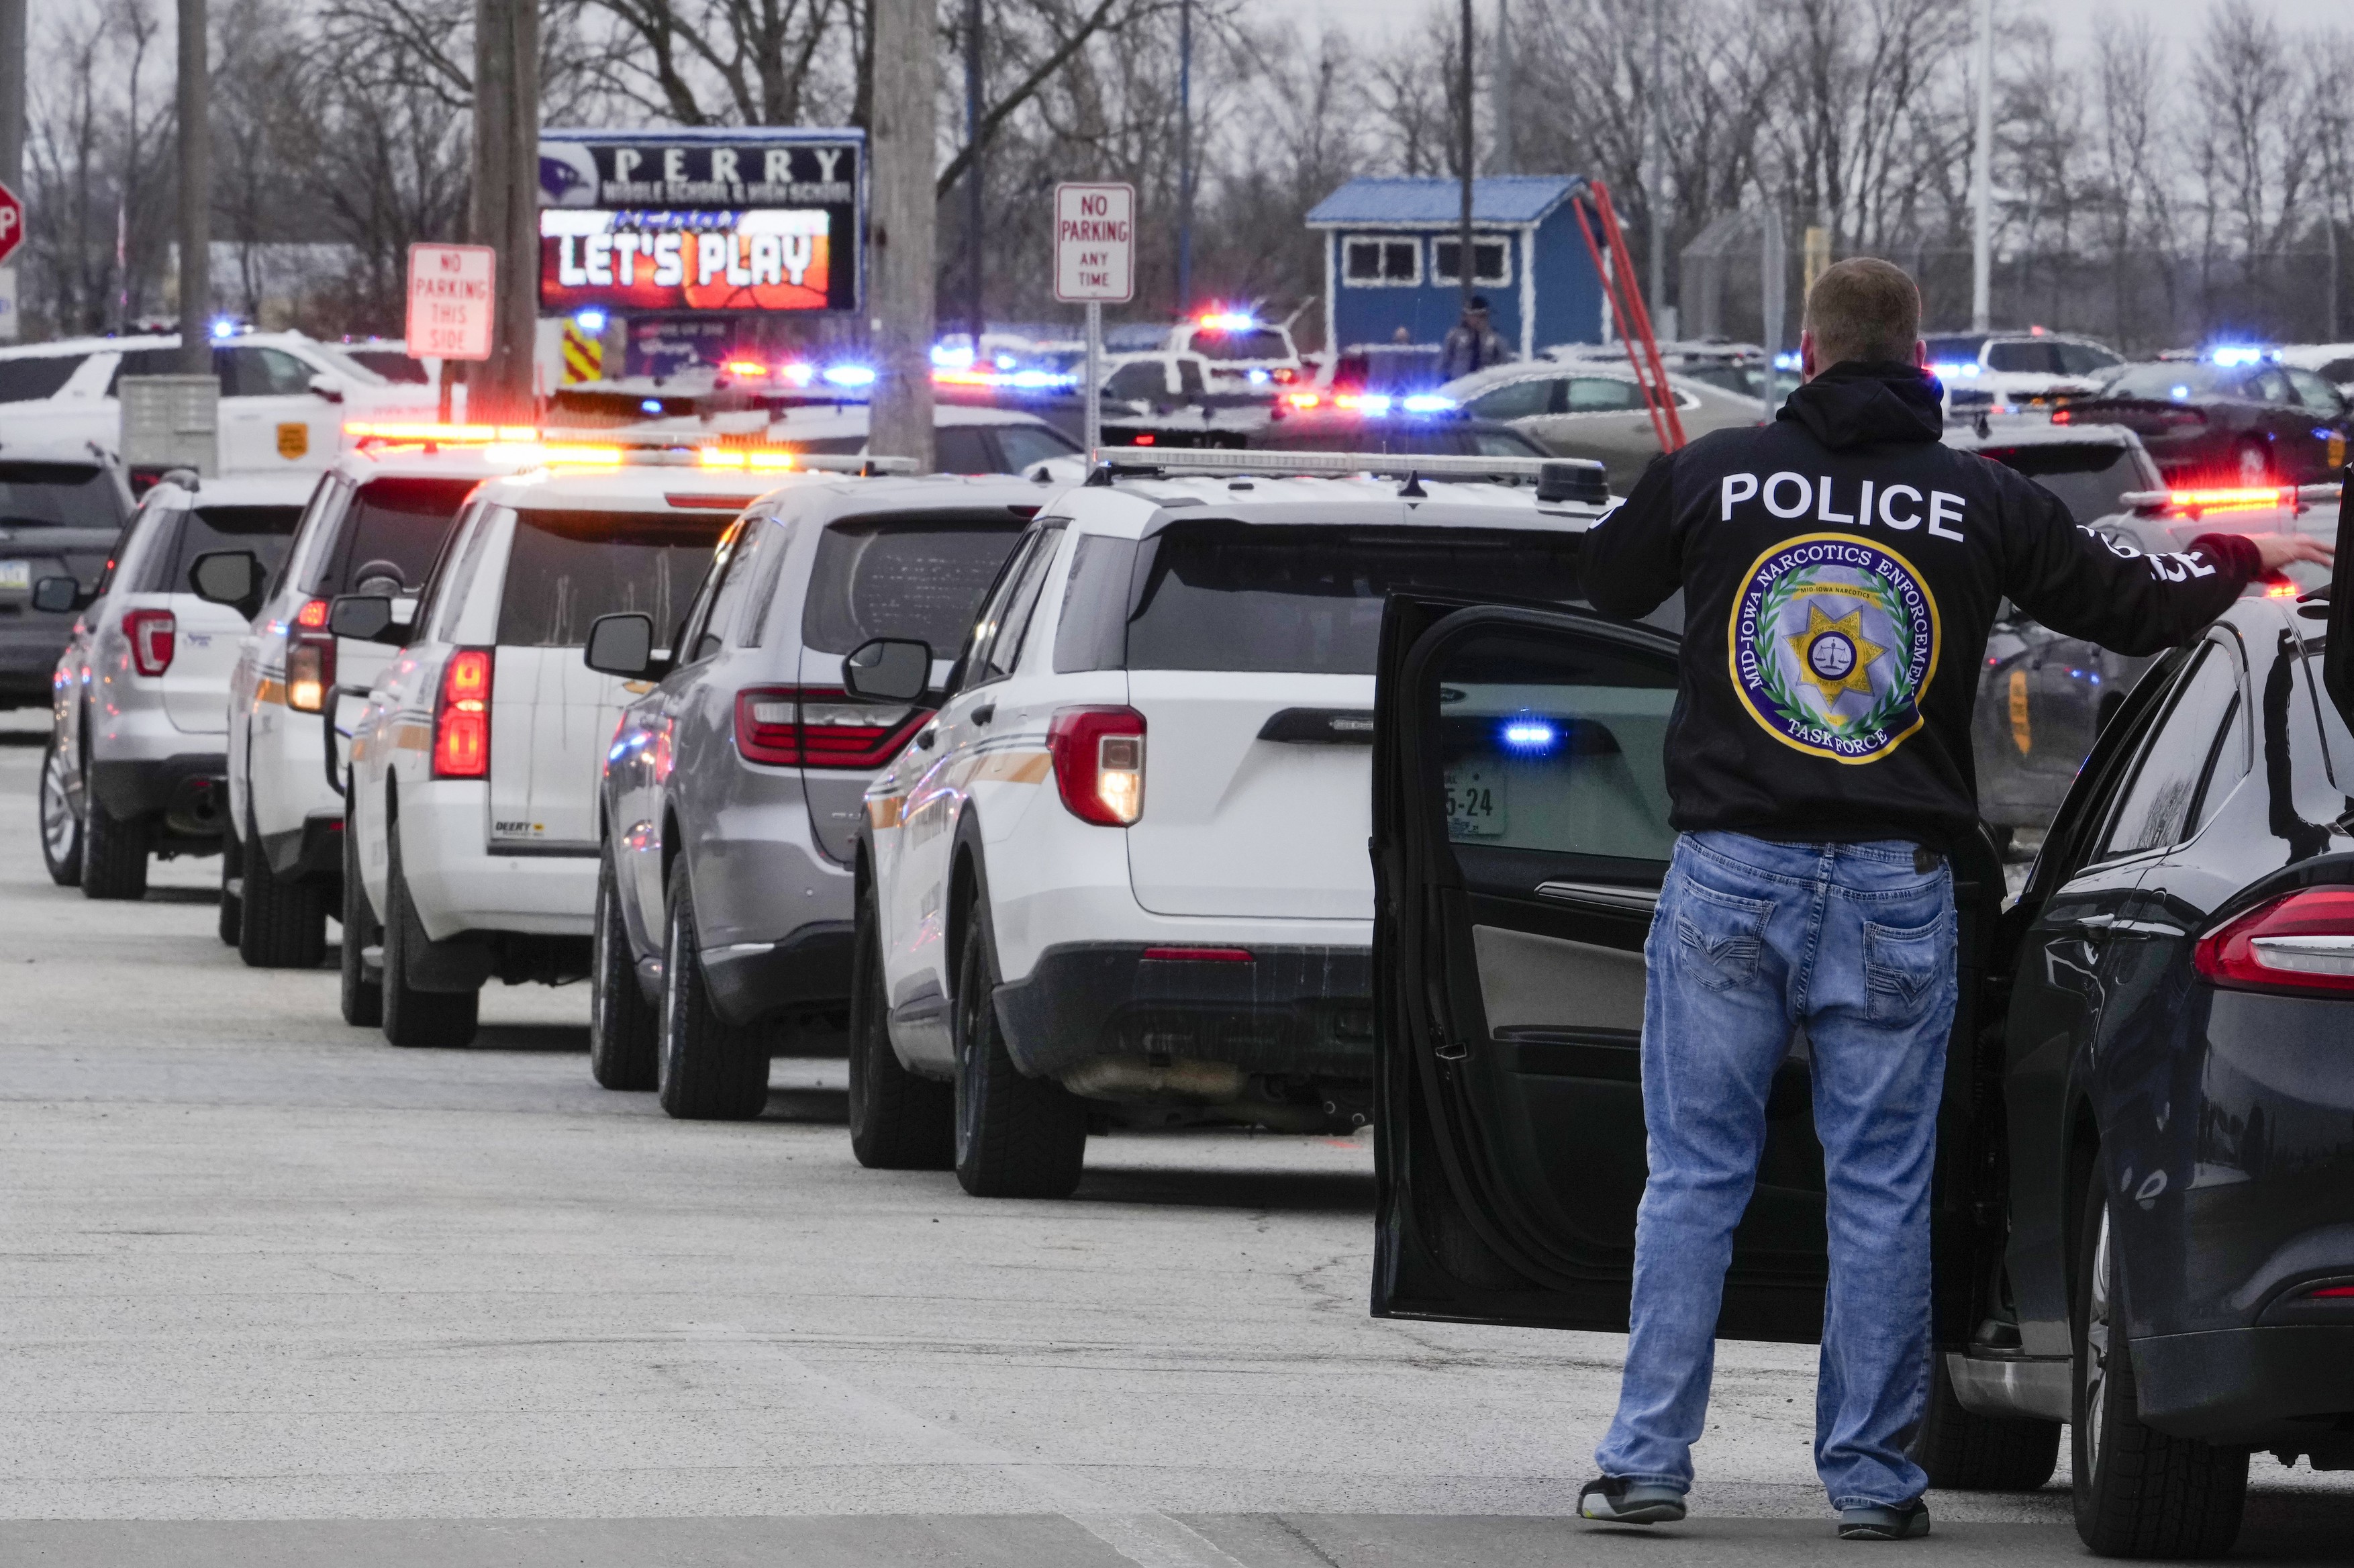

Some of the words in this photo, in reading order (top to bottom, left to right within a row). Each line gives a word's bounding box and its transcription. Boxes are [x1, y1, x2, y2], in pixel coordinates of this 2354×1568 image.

[614, 148, 842, 183] PERRY
[1081, 195, 1108, 216] NO
[1061, 219, 1128, 242] PARKING
[440, 253, 461, 273] NO
[558, 232, 683, 287] LET'S
[697, 232, 813, 287] PLAY
[1080, 252, 1108, 266] ANY
[415, 277, 487, 299] PARKING
[1079, 272, 1110, 286] TIME
[432, 303, 467, 325] THIS
[429, 329, 466, 350] SIDE
[1721, 471, 1966, 542] POLICE
[1835, 587, 1870, 598] NARCOTICS
[1740, 591, 1763, 690] MID-IOWA
[1757, 544, 1873, 588] NARCOTICS
[1787, 718, 1834, 748] TASK
[1834, 728, 1887, 754] FORCE
